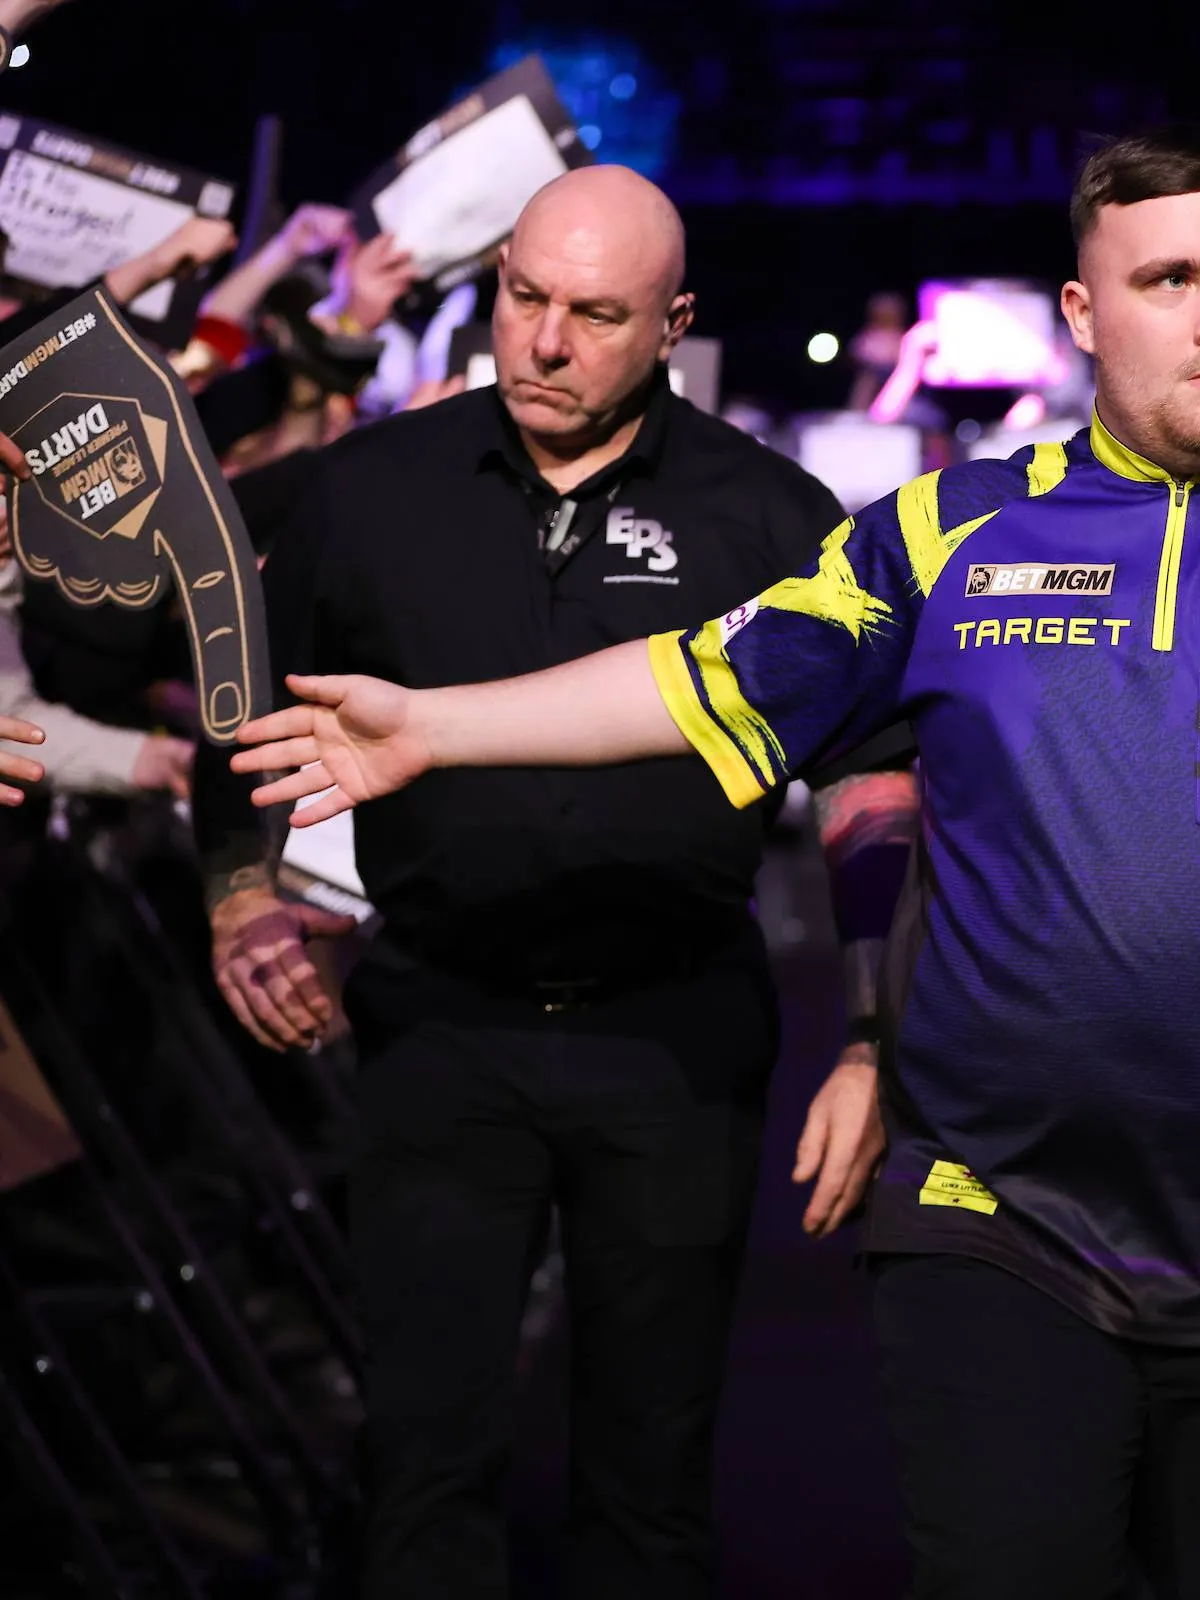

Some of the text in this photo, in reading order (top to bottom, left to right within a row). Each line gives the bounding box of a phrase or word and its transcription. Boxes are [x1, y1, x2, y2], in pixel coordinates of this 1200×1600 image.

[25, 403, 109, 475] DARTS
[88, 420, 128, 457] PREMIER
[60, 457, 111, 503] MGM
[80, 478, 117, 520] BET
[606, 507, 678, 572] EPS
[991, 568, 1112, 592] BETMGM
[953, 617, 1131, 650] TARGET
